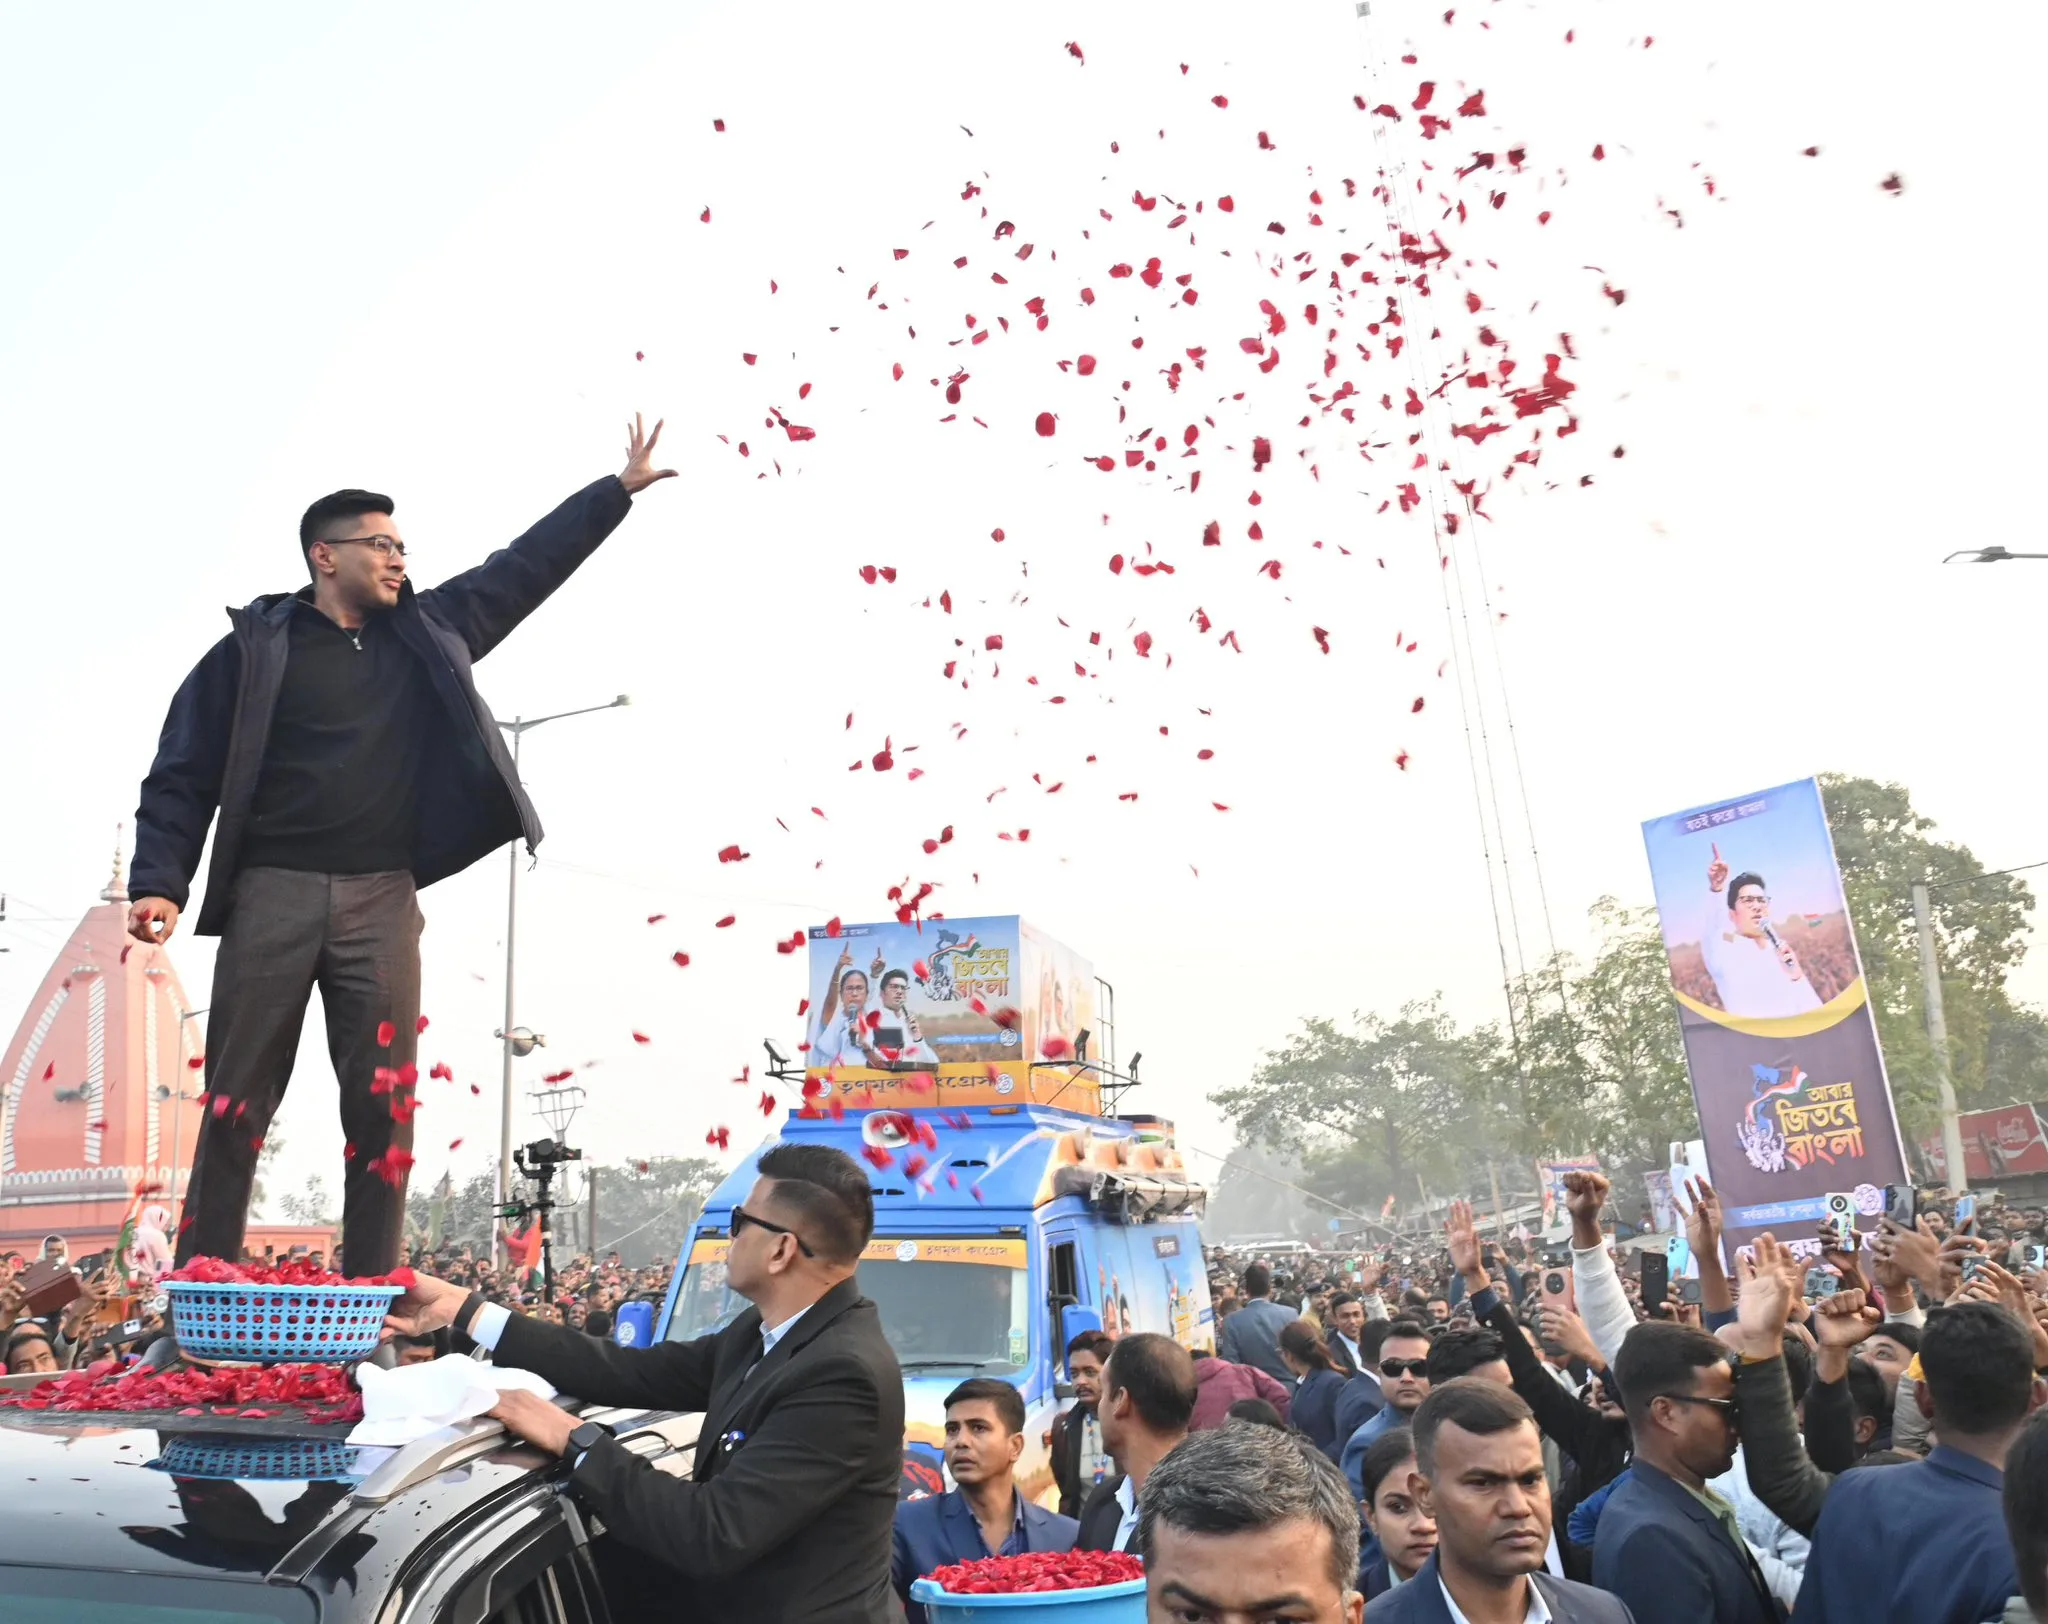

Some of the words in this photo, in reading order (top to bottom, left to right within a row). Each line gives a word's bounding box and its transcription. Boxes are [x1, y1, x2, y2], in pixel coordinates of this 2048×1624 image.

[952, 955, 1009, 978] জিতবে
[953, 977, 1010, 999] বাংলা
[835, 1078, 904, 1095] তৃণমূল
[932, 1075, 997, 1089] ংগ্রেস
[1804, 1081, 1854, 1102] আবার
[1774, 1098, 1859, 1136] জিতবে
[1784, 1125, 1865, 1166] বাংলা
